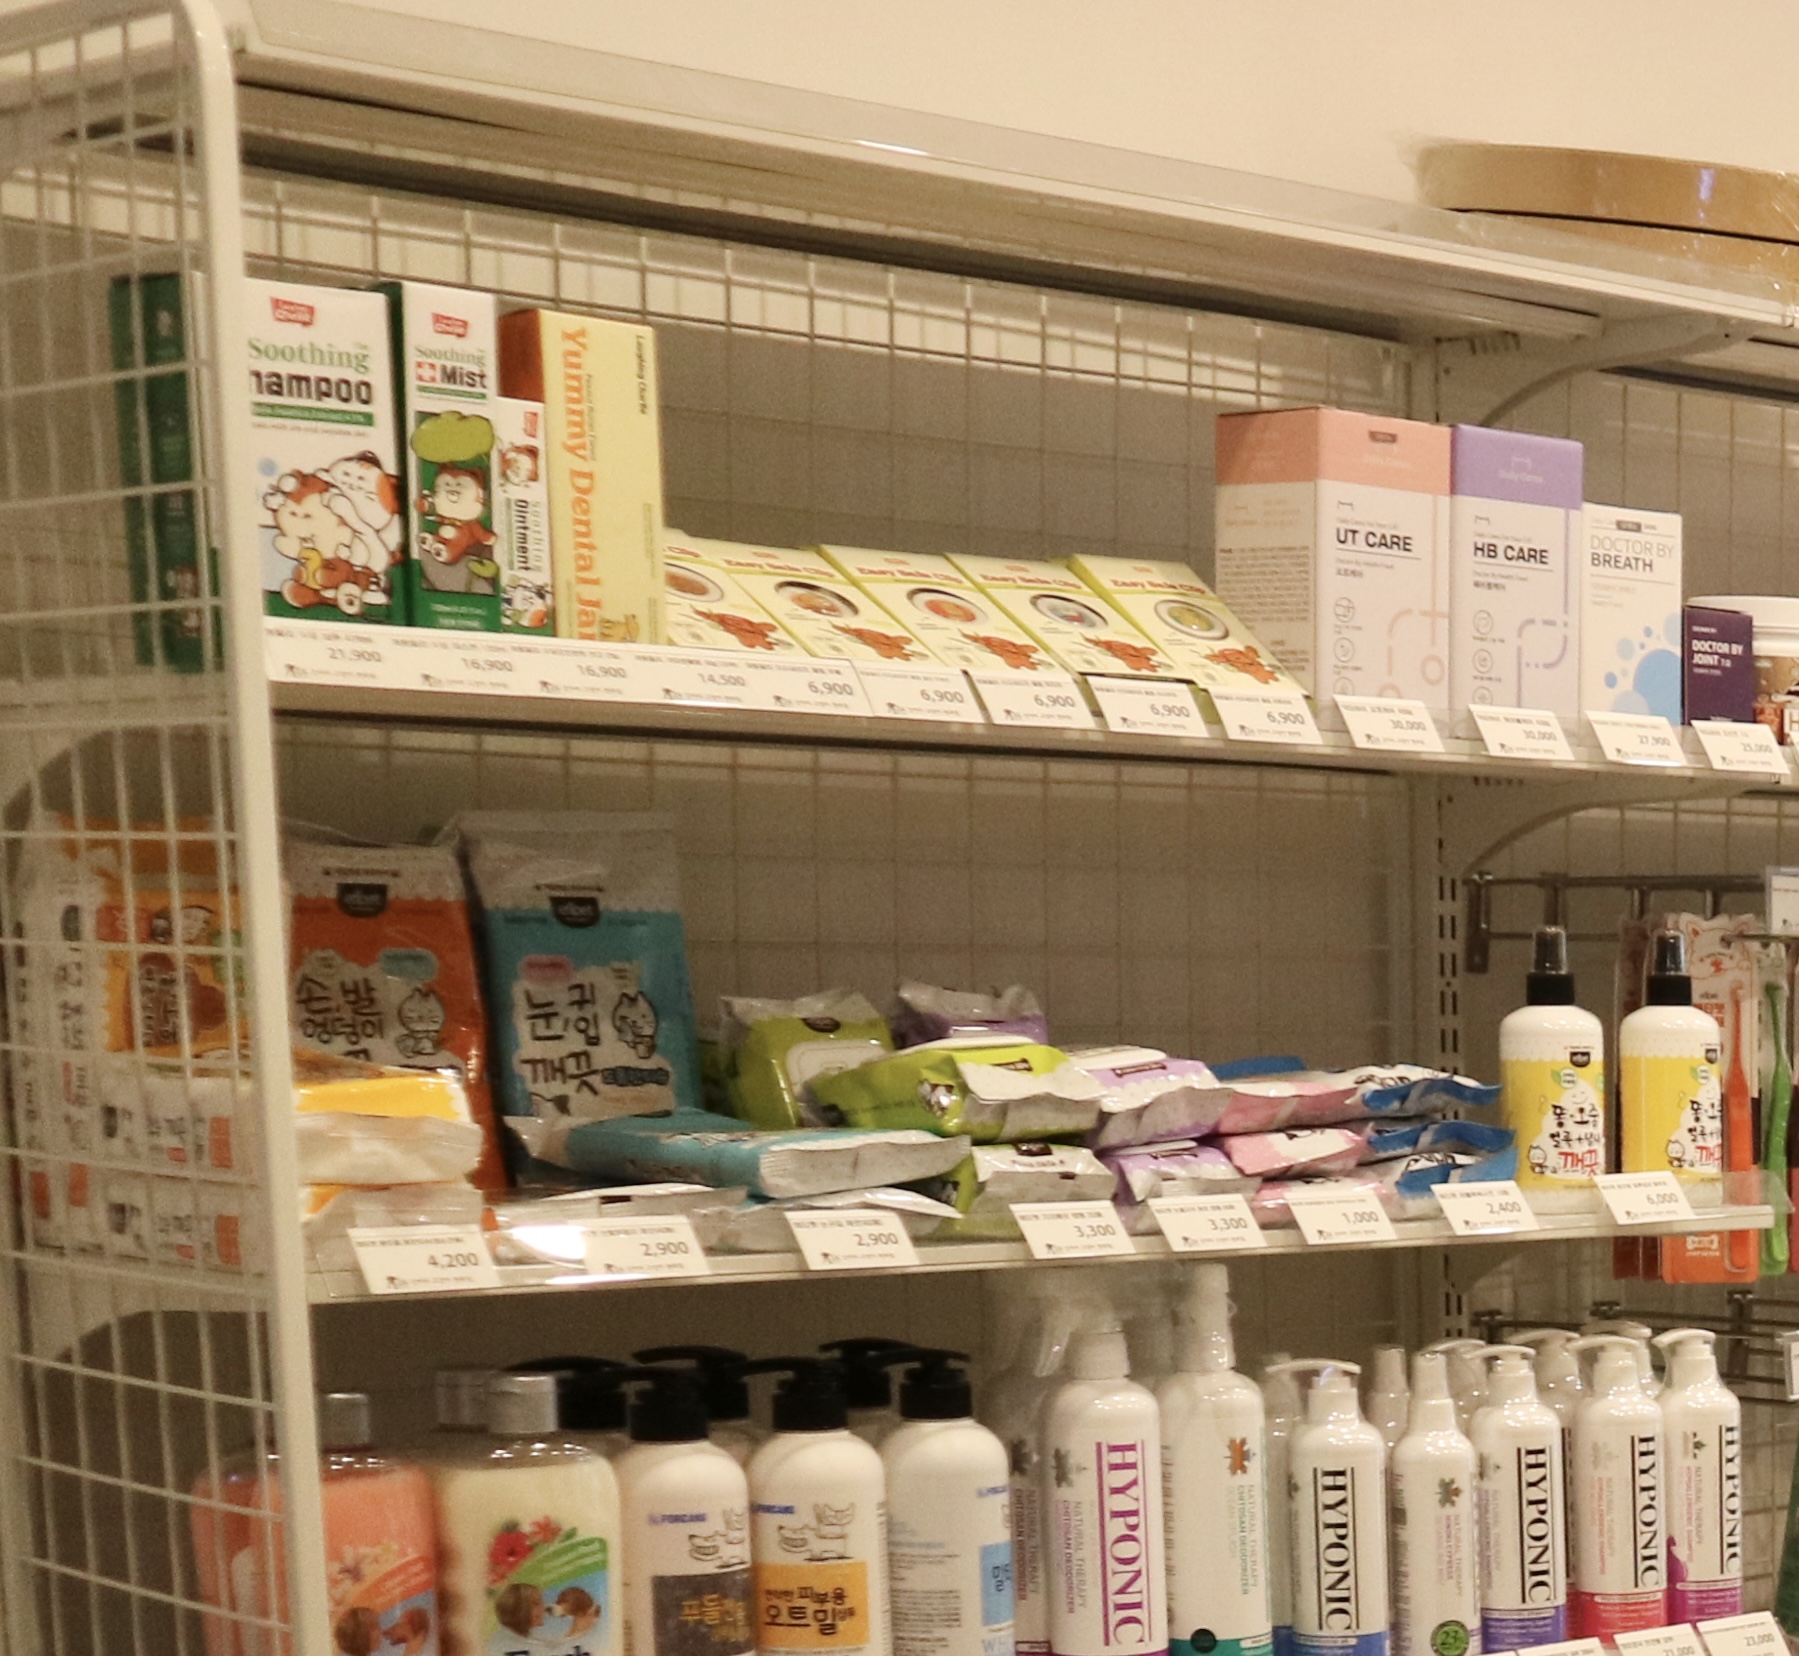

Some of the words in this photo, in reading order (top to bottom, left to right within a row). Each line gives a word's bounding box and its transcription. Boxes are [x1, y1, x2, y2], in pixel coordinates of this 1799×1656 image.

[248, 338, 370, 374] Soothing
[415, 347, 485, 367] Soothing
[441, 365, 487, 389] Mist
[561, 327, 588, 462] Yummy
[515, 499, 529, 571] Ointment
[569, 467, 602, 587] Dental
[1336, 527, 1360, 546] UT
[1365, 531, 1413, 553] CARE
[1590, 536, 1651, 554] DOCTOR
[1655, 542, 1674, 557] BY
[1473, 541, 1498, 560] HB
[1503, 543, 1549, 565] CARE
[1590, 552, 1654, 573] BREATH
[1266, 711, 1306, 726] 6,900
[1341, 1210, 1380, 1225] 1,000
[428, 1252, 480, 1269] 4,200
[642, 1241, 689, 1257] 2,900
[1722, 1425, 1741, 1575] HYPONIC
[1106, 1442, 1147, 1646] HYPONIC
[1322, 1469, 1352, 1632] HYPONIC
[764, 1605, 837, 1636] 오트밀
